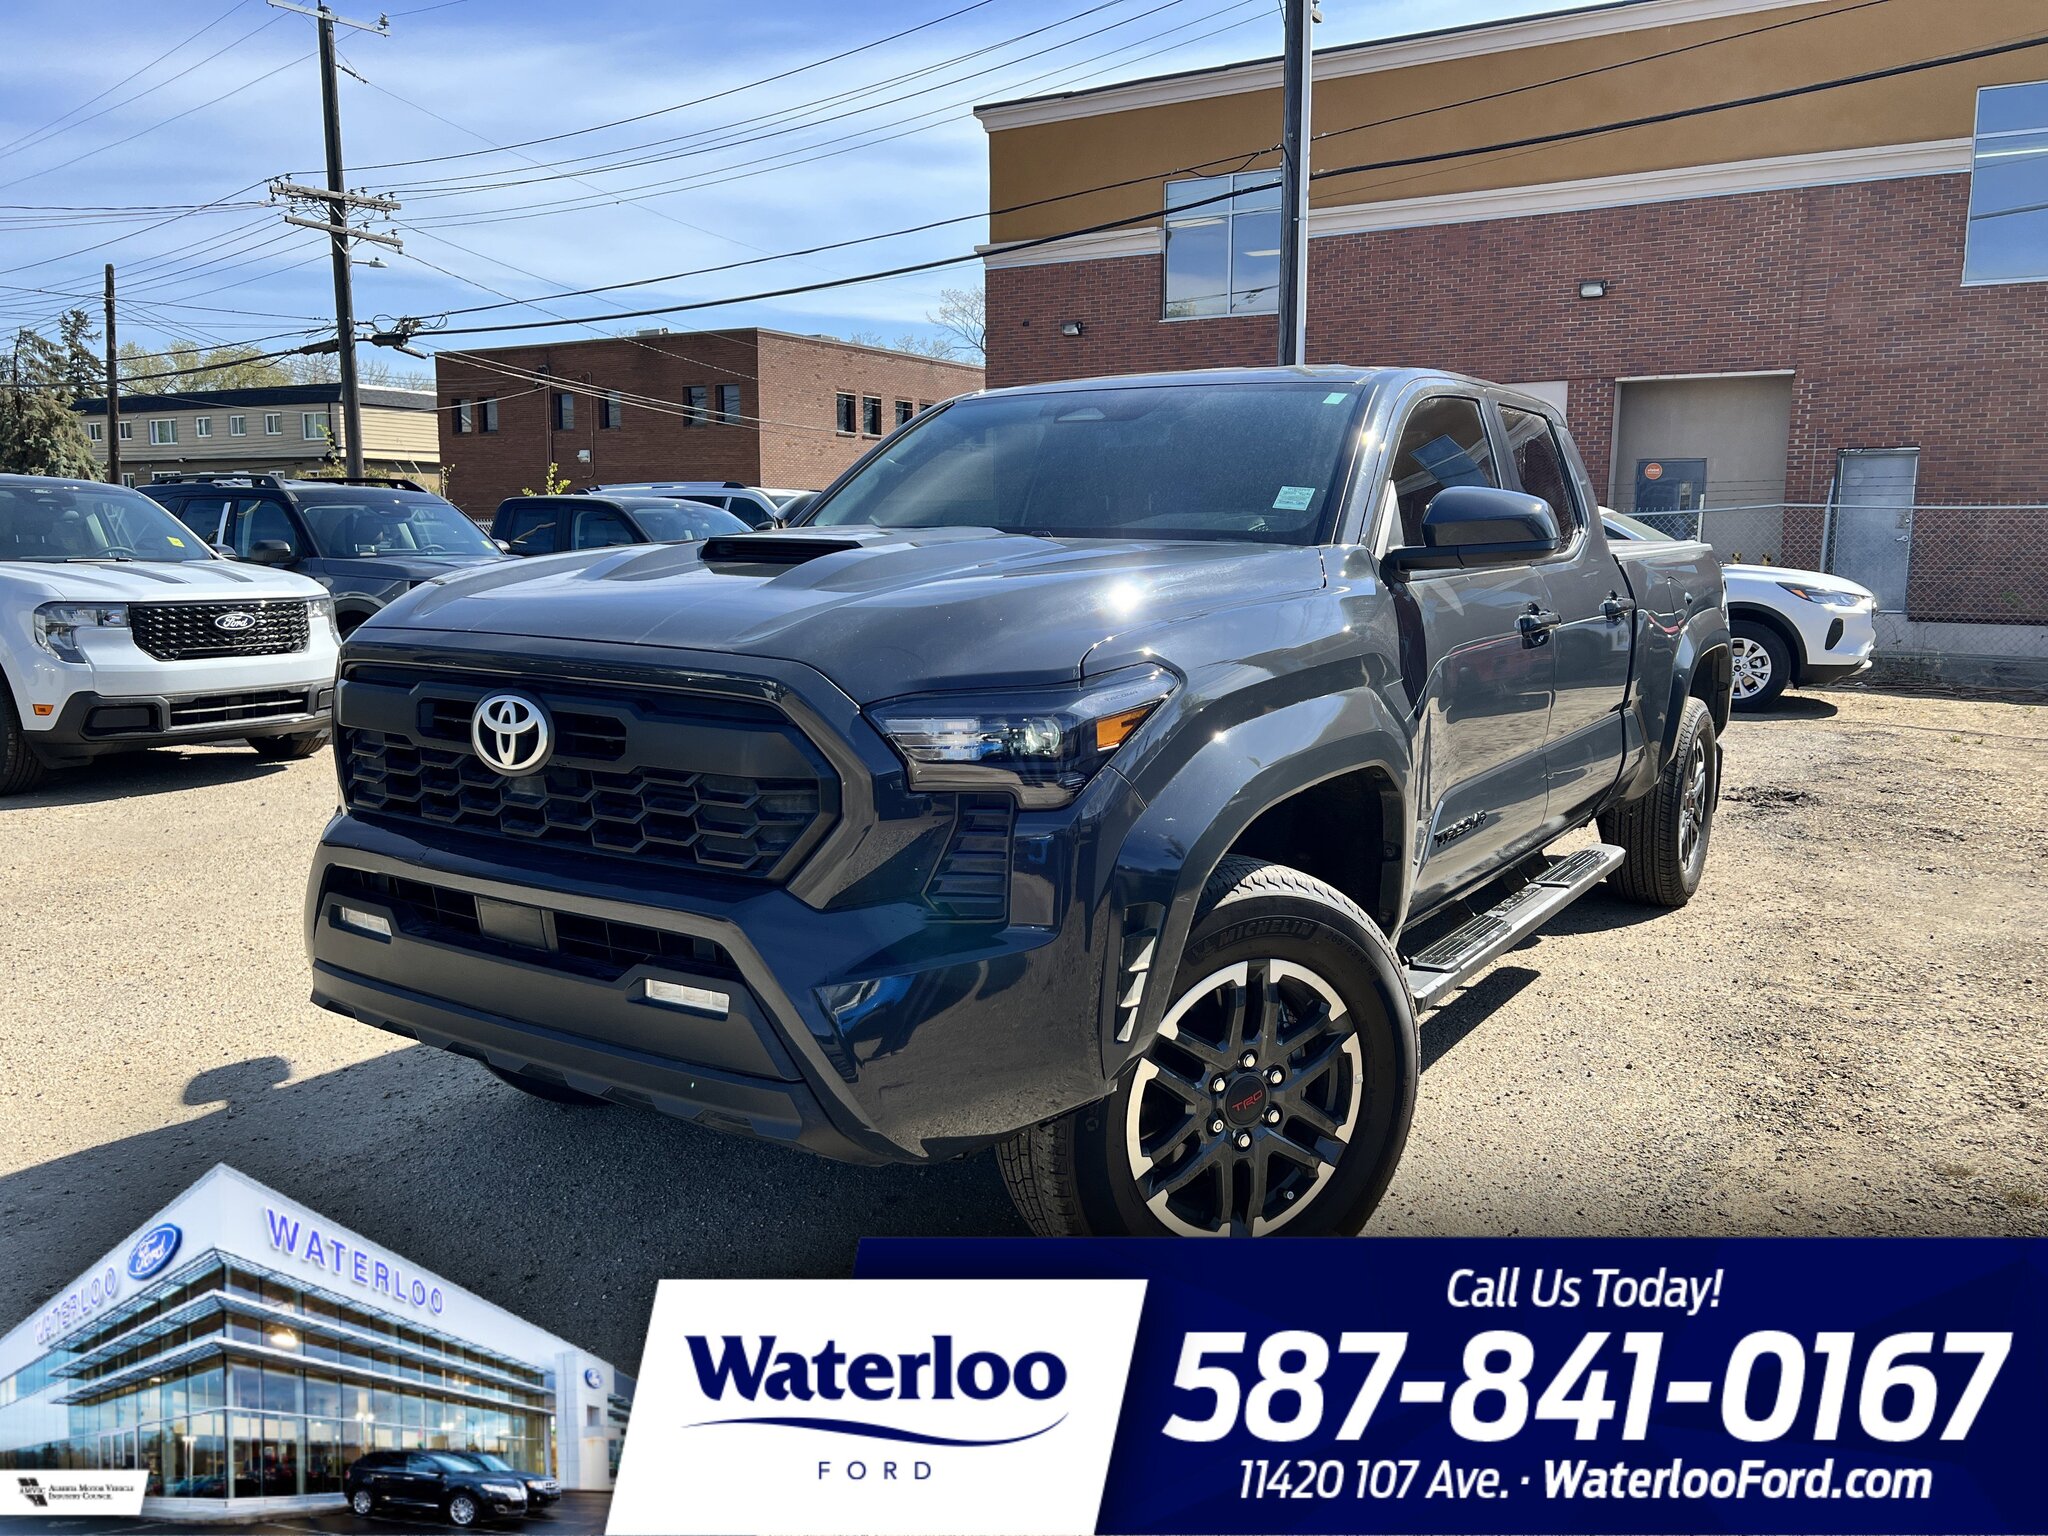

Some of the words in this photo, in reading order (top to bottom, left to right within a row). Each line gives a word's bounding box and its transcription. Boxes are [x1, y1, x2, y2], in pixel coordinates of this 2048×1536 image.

[223, 616, 248, 627] Ford
[1218, 919, 1315, 948] MICHELIN
[1231, 1089, 1263, 1112] TRD
